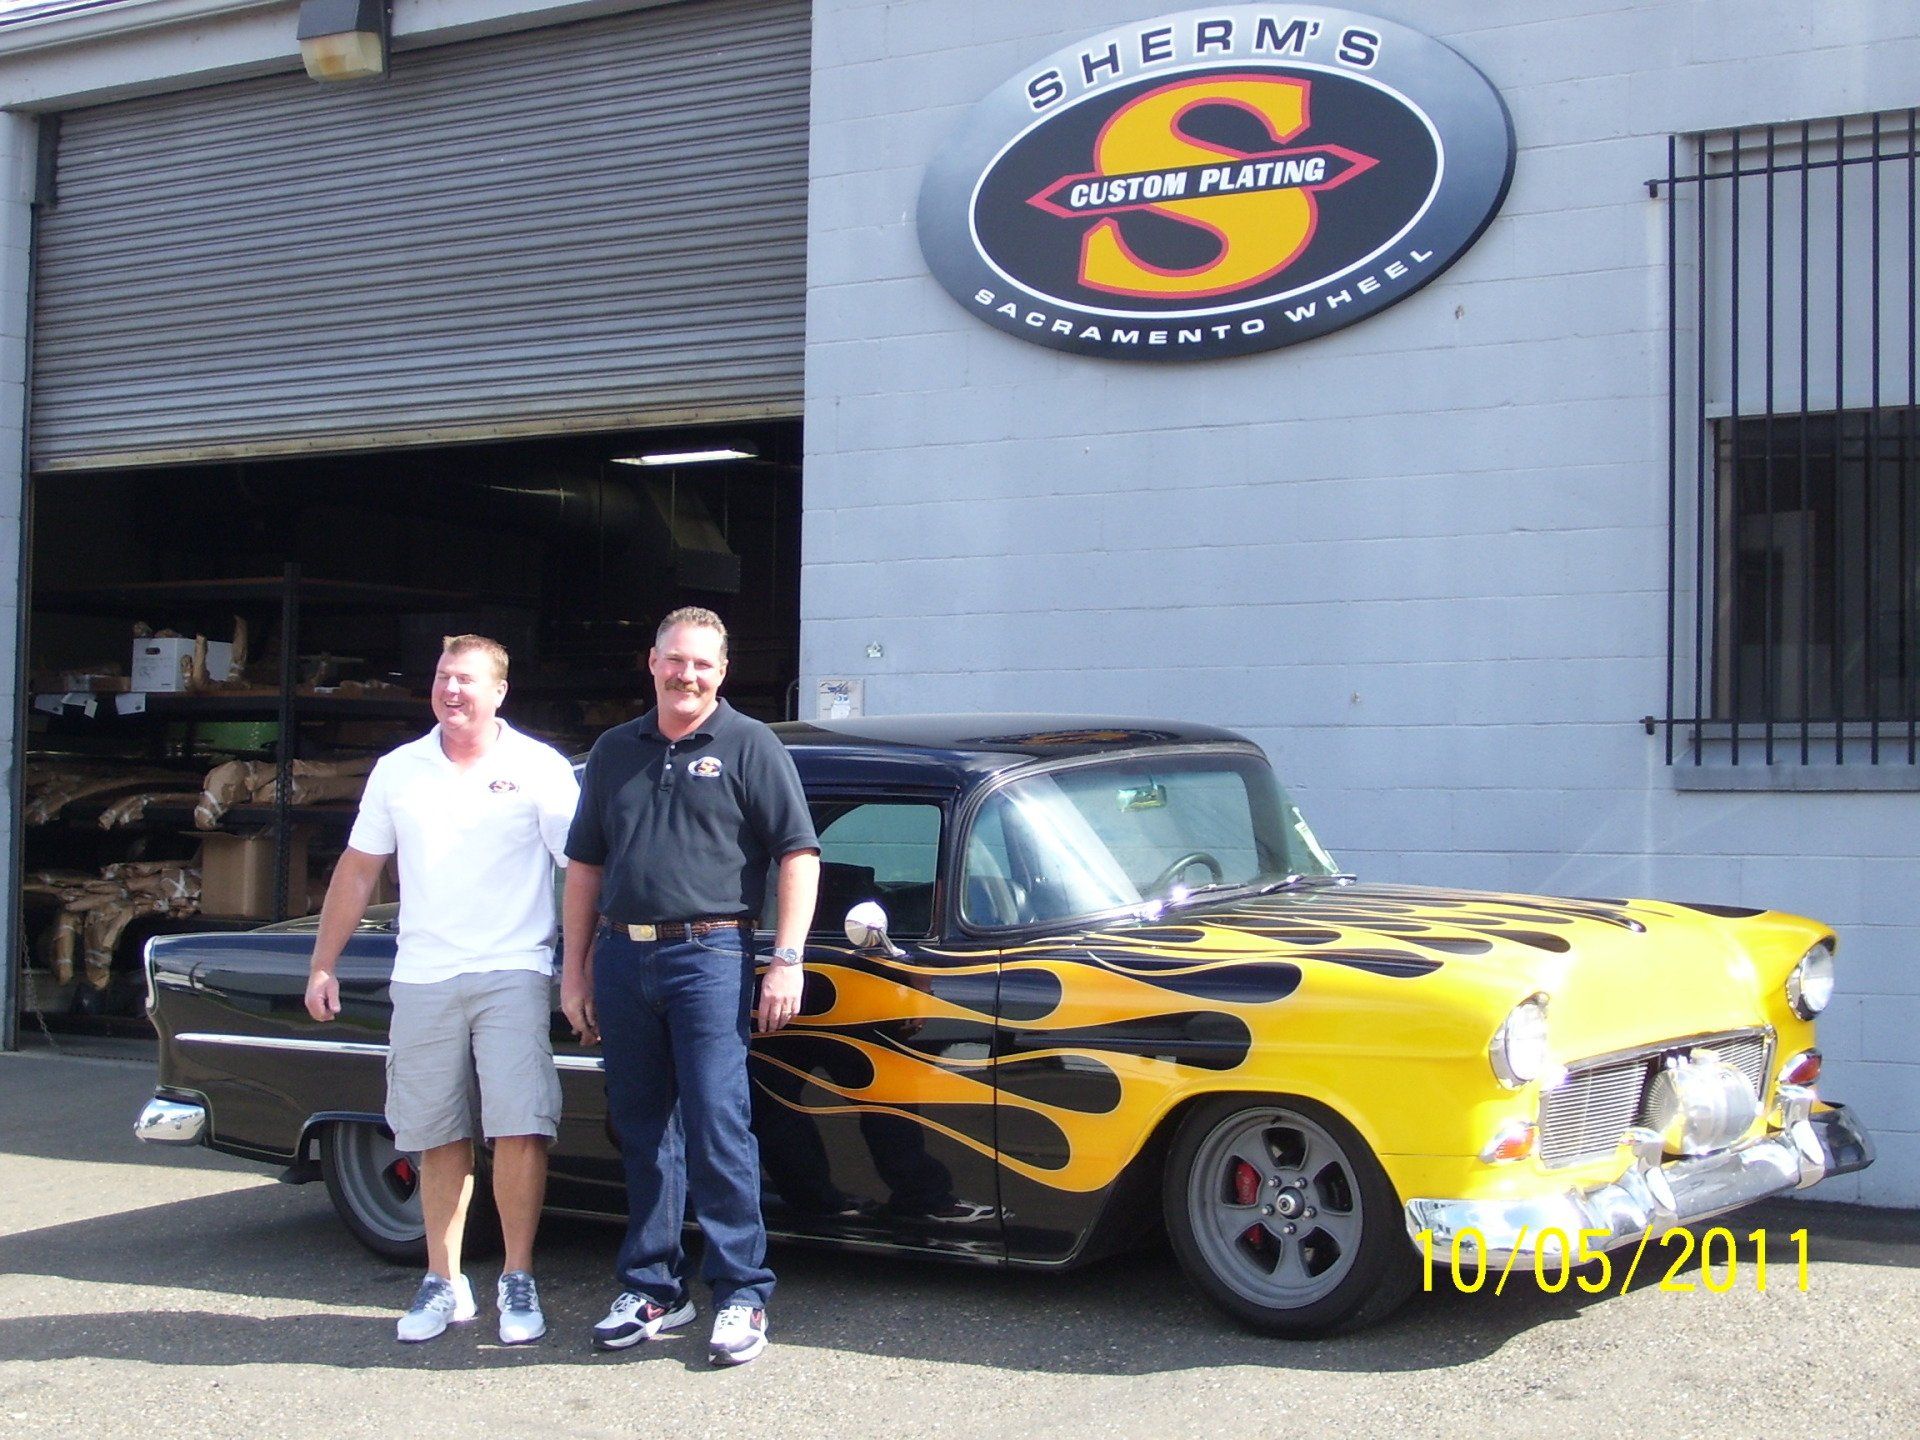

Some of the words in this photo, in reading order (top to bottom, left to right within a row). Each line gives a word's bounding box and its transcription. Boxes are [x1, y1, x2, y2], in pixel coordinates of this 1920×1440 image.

[1027, 17, 1382, 112] SHERM'S
[1070, 171, 1185, 208] CUSTOM
[1199, 156, 1326, 194] PLATING
[1078, 73, 1318, 300] S
[974, 288, 1264, 345] SACRAMENTO
[1285, 248, 1434, 323] WHEEL
